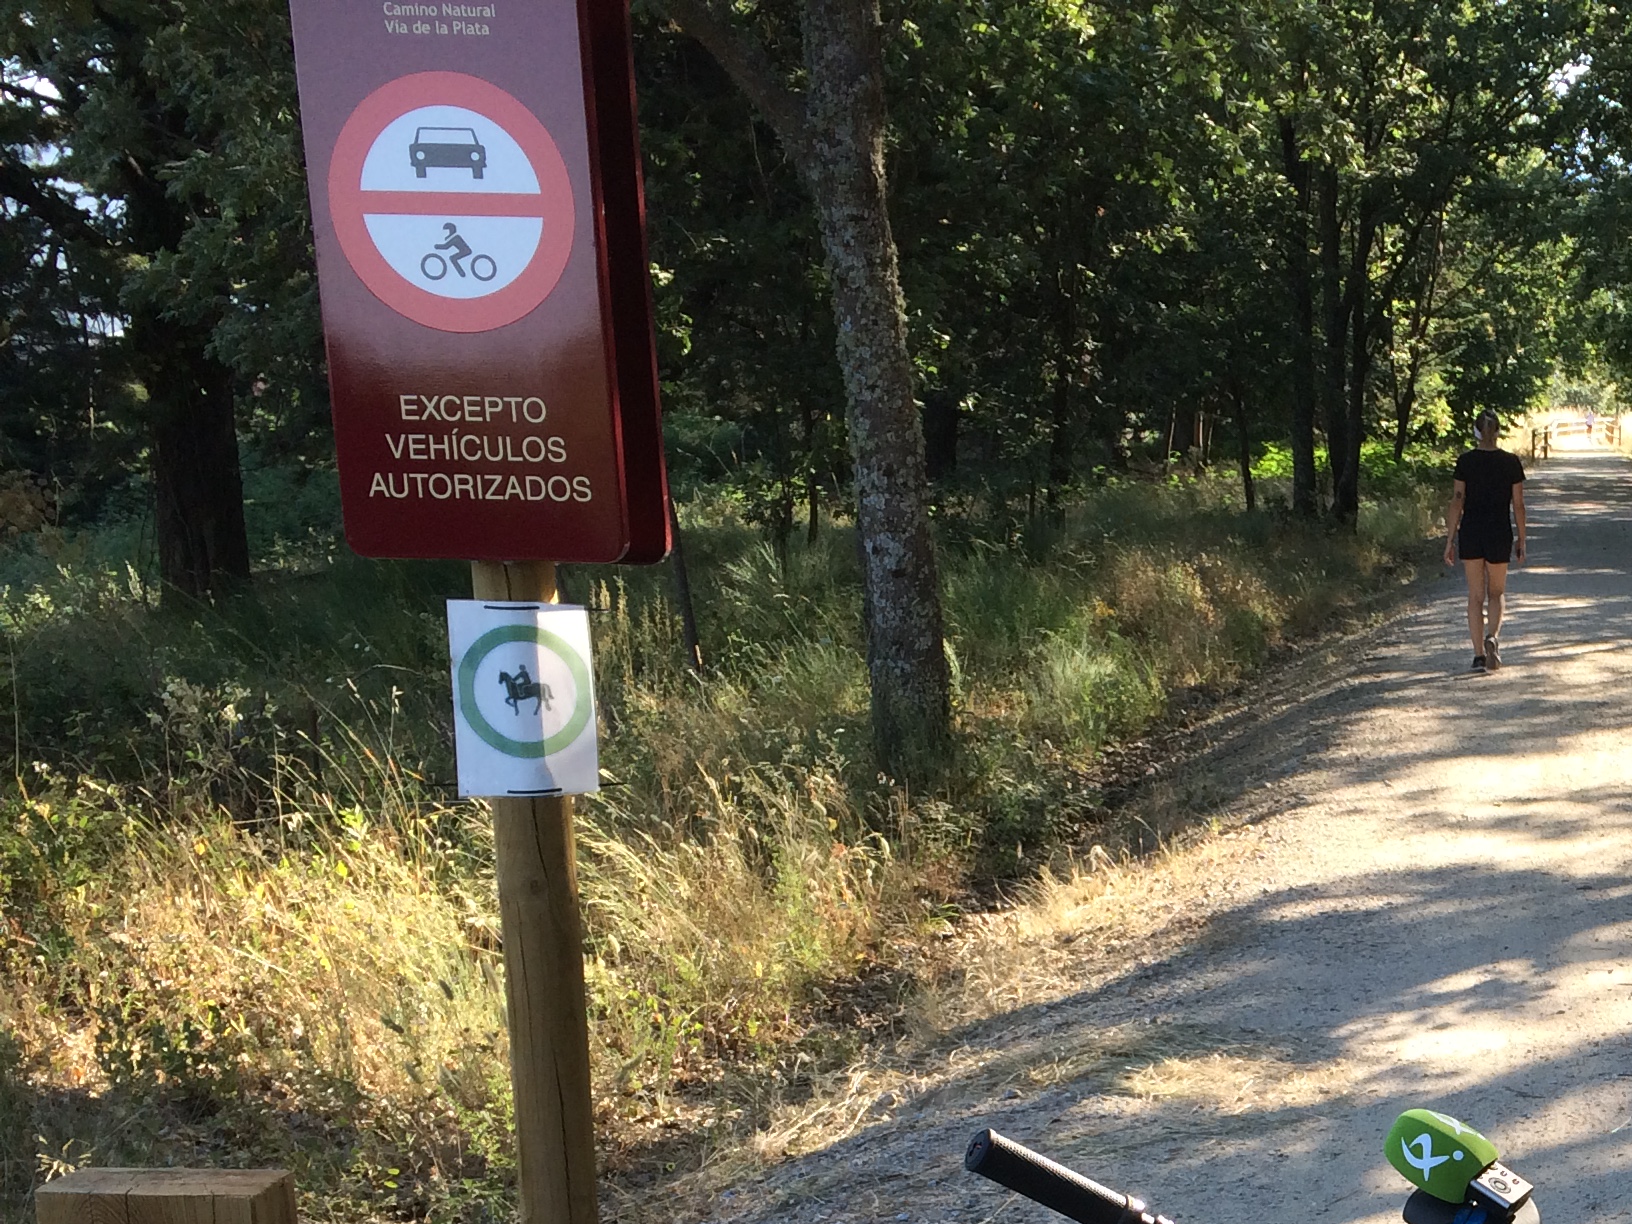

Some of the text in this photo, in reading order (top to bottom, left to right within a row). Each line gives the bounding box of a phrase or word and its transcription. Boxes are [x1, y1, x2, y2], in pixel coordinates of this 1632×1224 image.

[383, 1, 496, 18] Camino Natural
[412, 20, 431, 34] de
[435, 20, 449, 35] la
[452, 20, 490, 35] Plata
[400, 394, 547, 423] EXCEPTO
[385, 428, 568, 462] VEHÍCULOS
[369, 472, 593, 502] AUTORIZADOS
